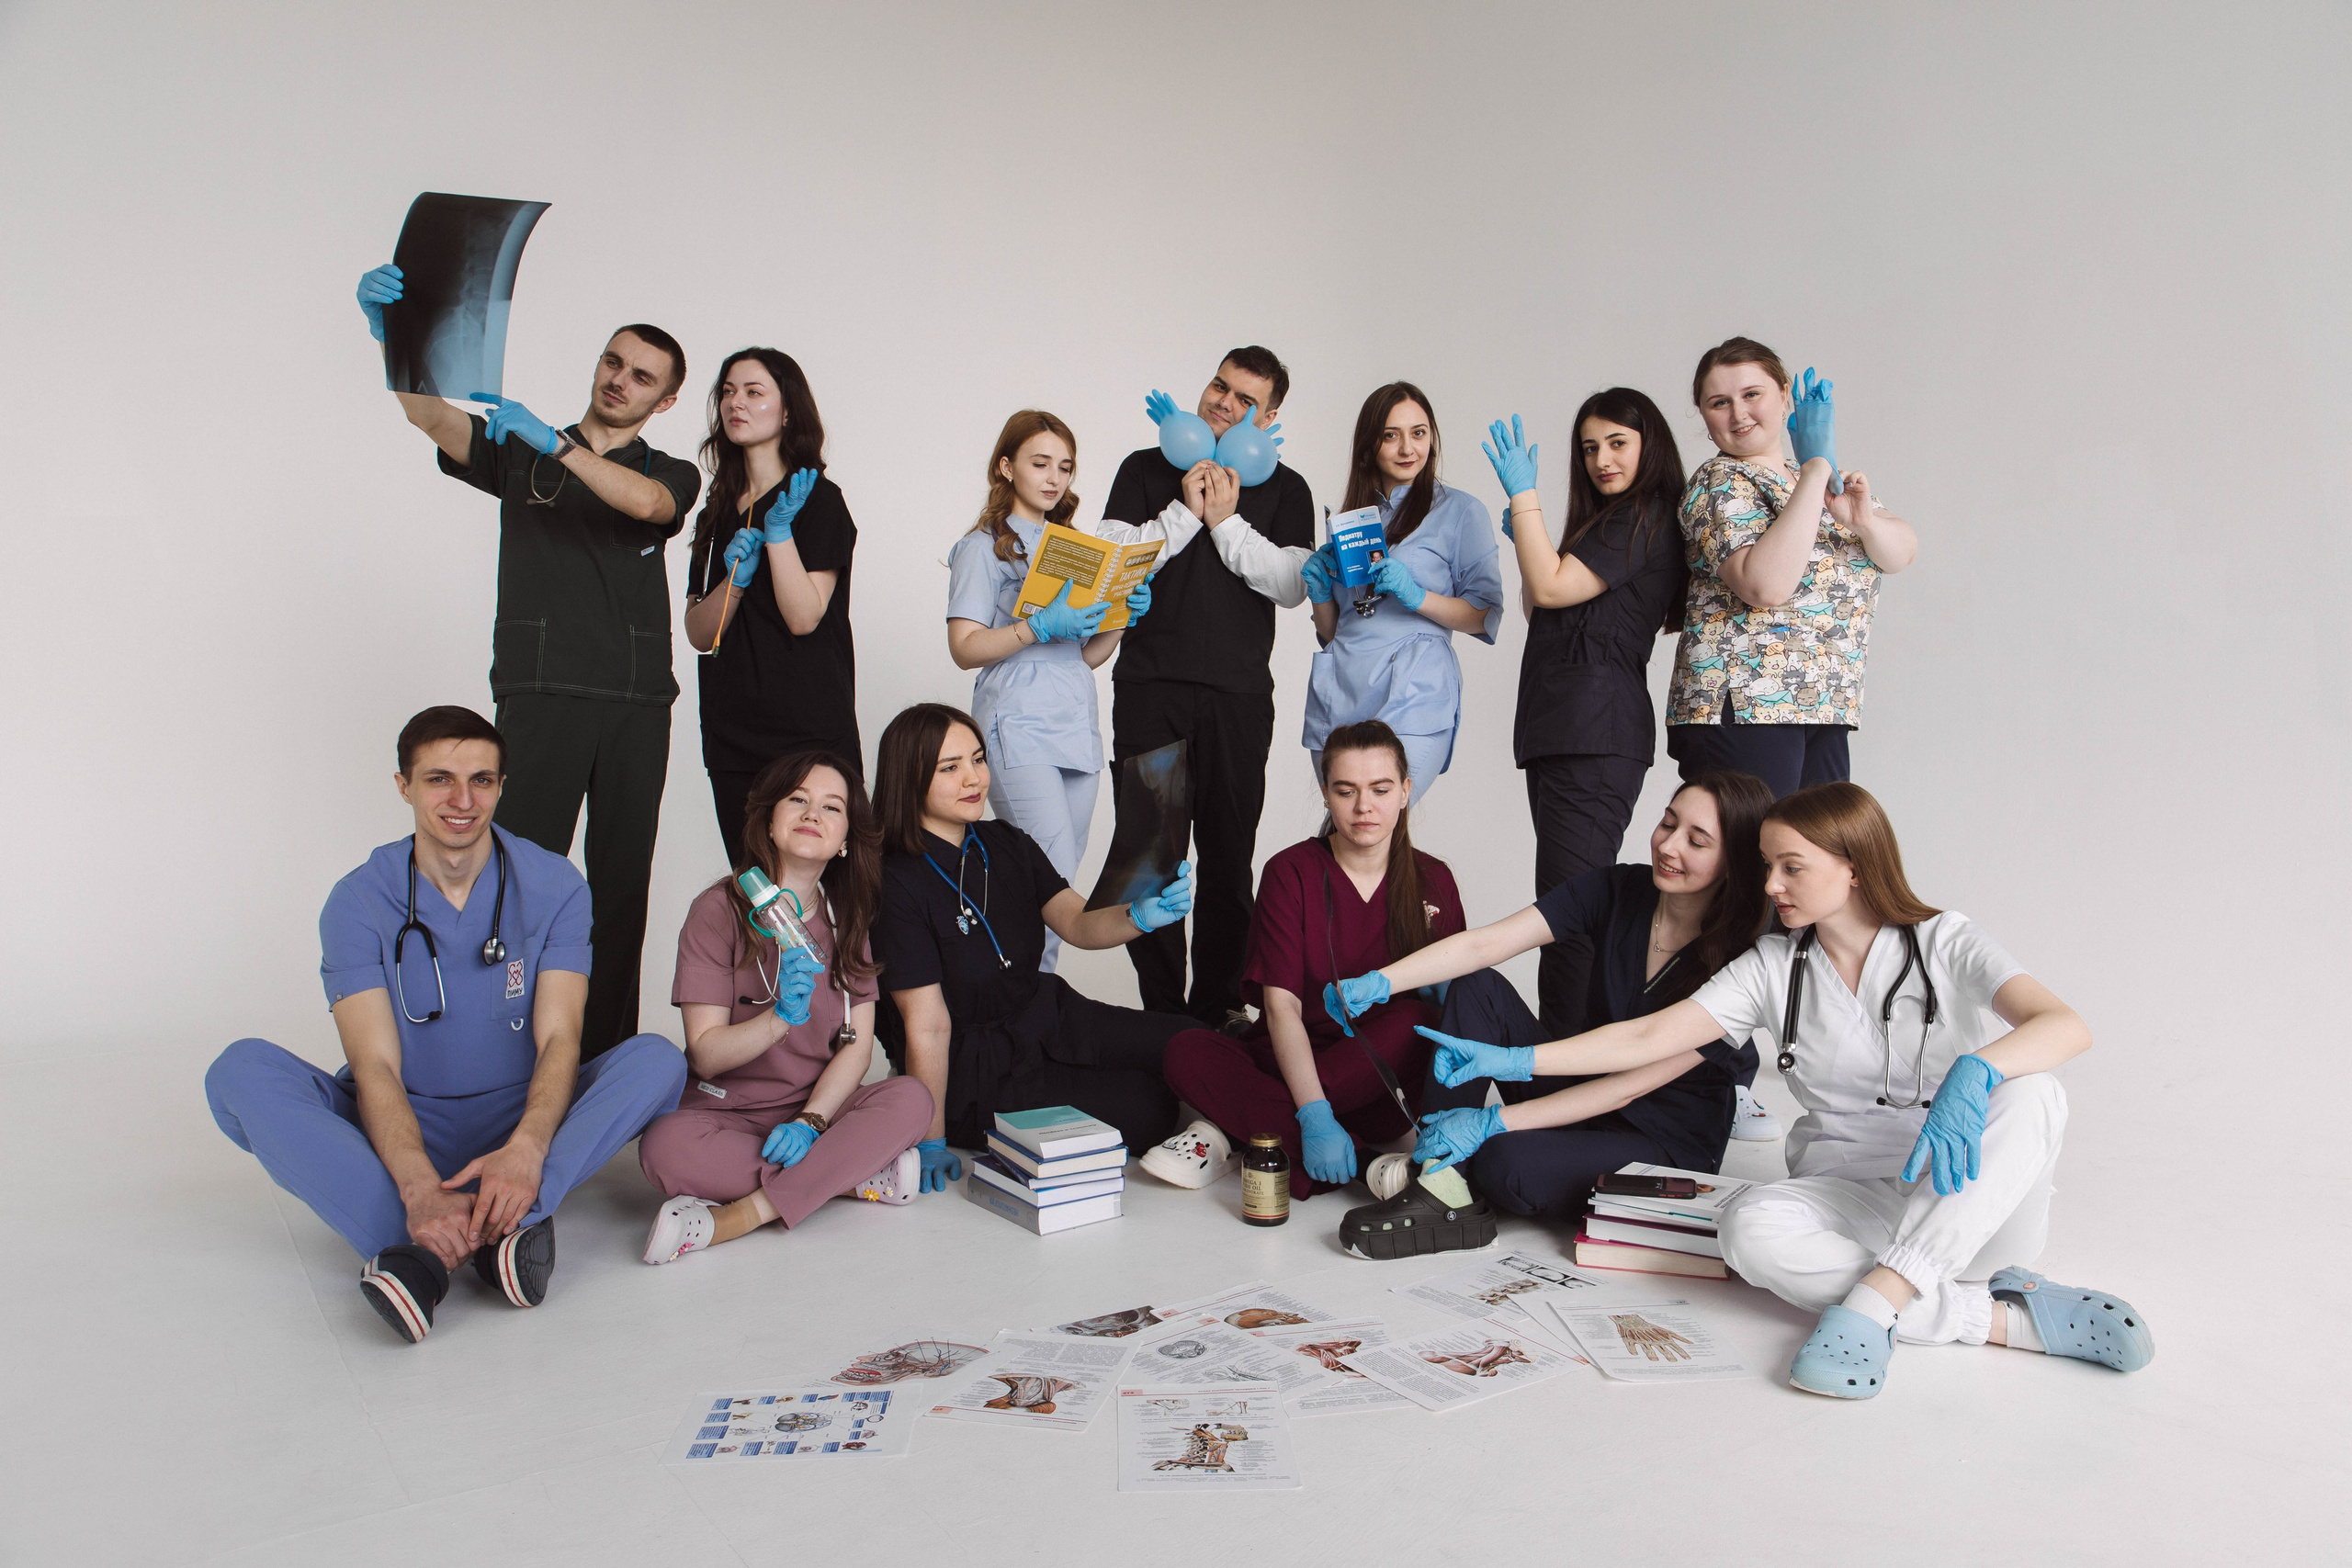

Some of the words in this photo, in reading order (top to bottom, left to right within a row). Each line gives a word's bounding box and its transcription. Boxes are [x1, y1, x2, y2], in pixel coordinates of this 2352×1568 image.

[1339, 532, 1363, 542] Педиатру
[1348, 538, 1369, 548] каждый
[1119, 567, 1148, 581] ТАКТИКА
[507, 987, 523, 997] ПИМУ
